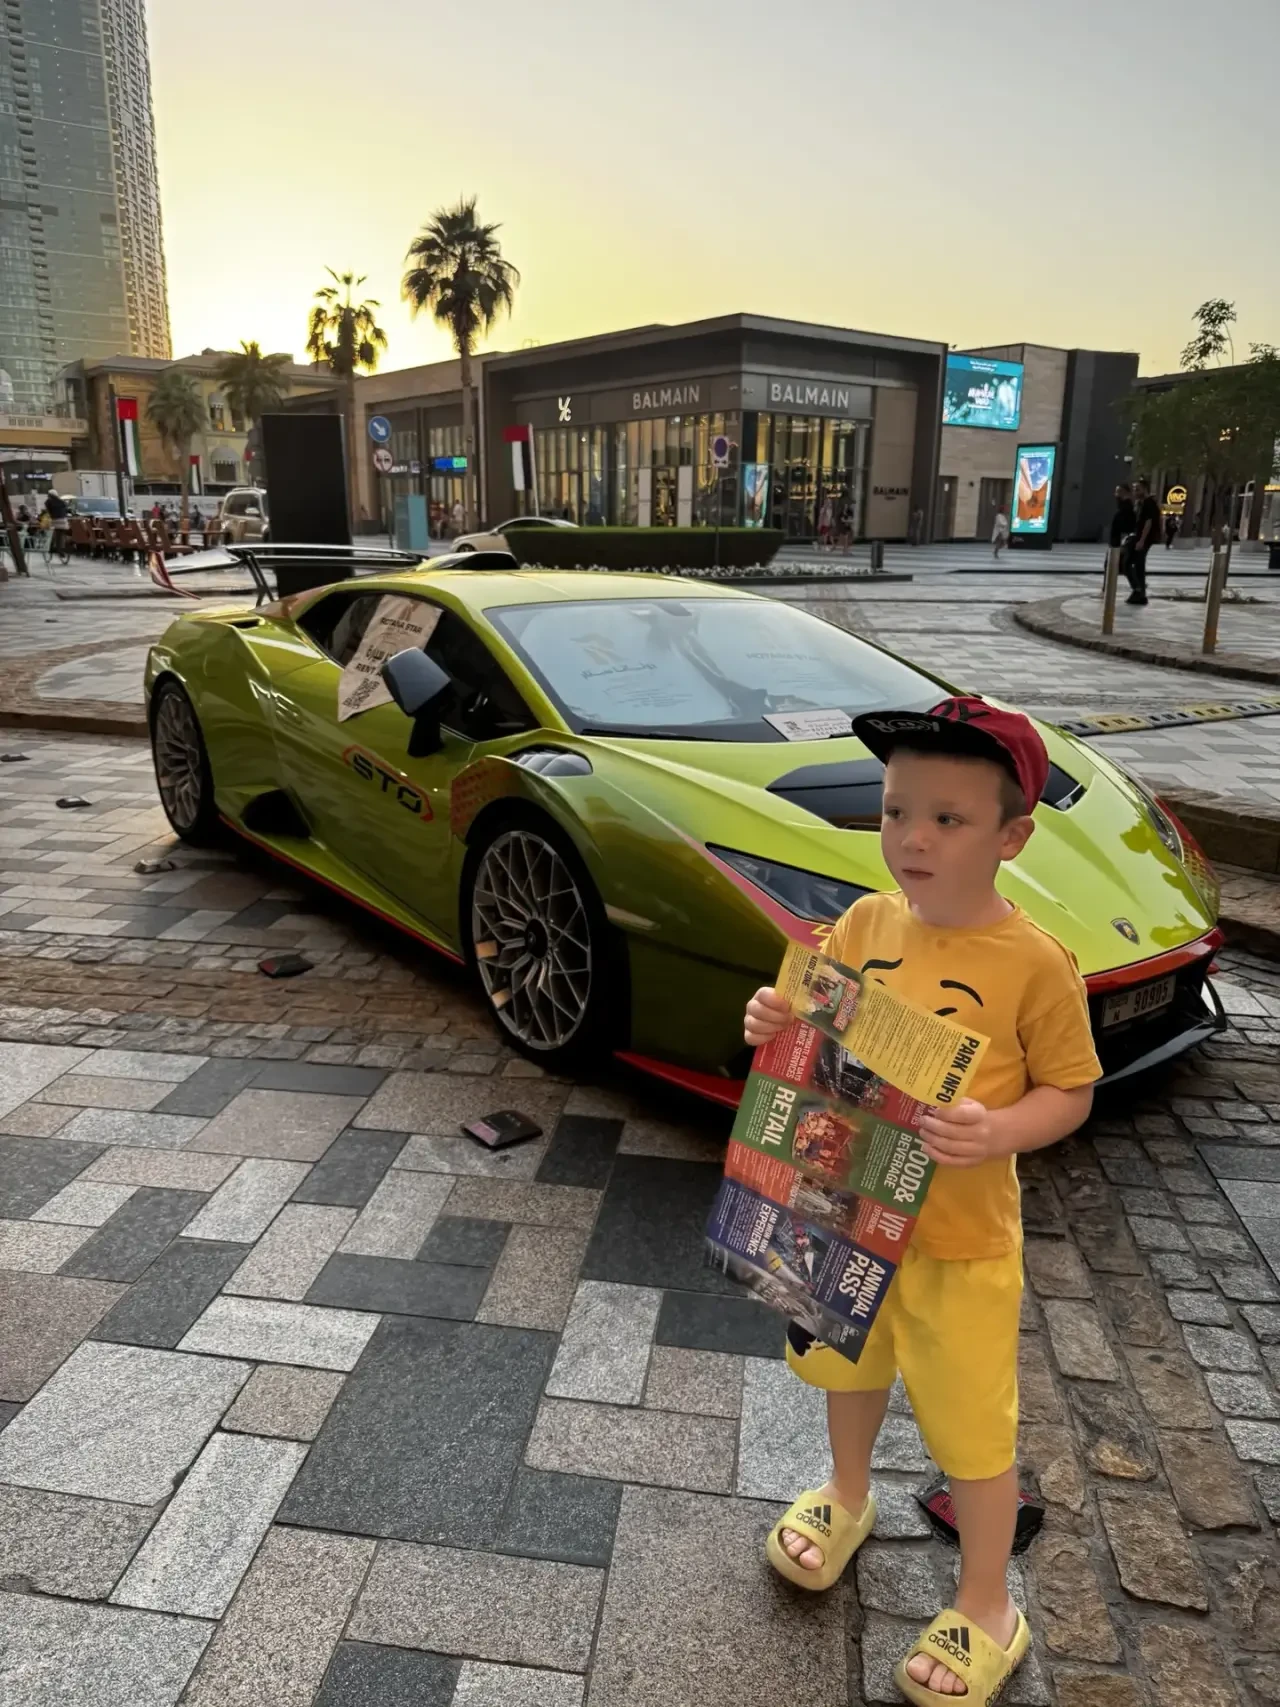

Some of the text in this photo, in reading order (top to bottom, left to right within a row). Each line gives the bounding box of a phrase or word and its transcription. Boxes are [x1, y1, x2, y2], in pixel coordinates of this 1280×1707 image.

[632, 386, 700, 410] BALMAIN
[771, 383, 849, 409] BALMAIN
[356, 663, 376, 674] RENT
[352, 754, 423, 815] STO
[802, 955, 818, 987] KIDS ZONE
[1134, 980, 1168, 1014] 90905
[795, 1029, 806, 1047] MICE
[785, 1046, 802, 1079] SERVICES
[794, 1066, 804, 1082] DAYS
[935, 1035, 980, 1104] PARK INFO
[760, 1086, 796, 1146] RETAIL
[883, 1132, 912, 1190] BEVERAGE
[745, 1203, 771, 1256] EXPERIENCE
[764, 1223, 774, 1238] IRON
[769, 1212, 777, 1223] AM
[866, 1205, 882, 1235] EXPERIENCE
[875, 1212, 907, 1242] VIP
[758, 1238, 768, 1254] MAN
[837, 1250, 869, 1298] PASS
[850, 1260, 885, 1318] ANNUAL
[796, 1510, 832, 1538] adidas
[928, 1631, 972, 1668] adidas
